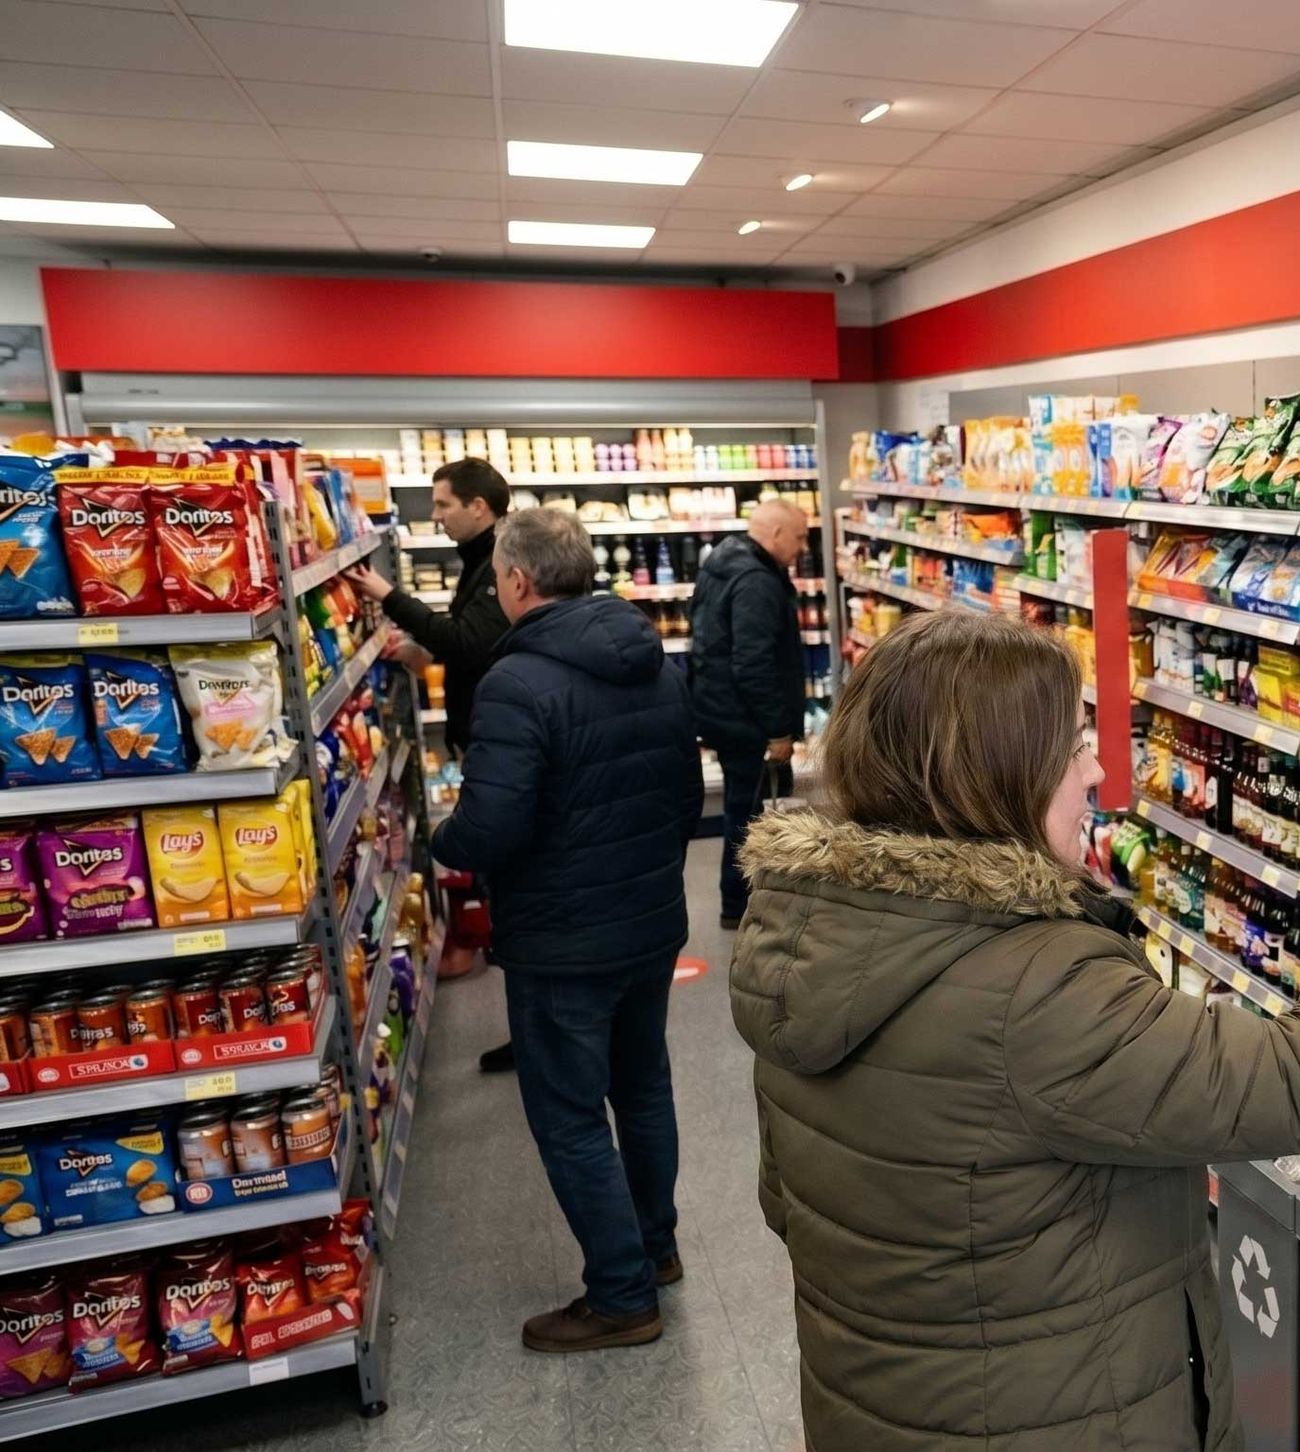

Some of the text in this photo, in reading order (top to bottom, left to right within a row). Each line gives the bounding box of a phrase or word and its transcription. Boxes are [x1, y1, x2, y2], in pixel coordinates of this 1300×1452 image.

[72, 508, 145, 526] Doritos
[166, 508, 234, 525] Doritos
[3, 682, 74, 703] Doritos
[94, 679, 159, 698] Doritos
[56, 847, 123, 867] Doritos
[166, 1277, 231, 1300] Doritos
[73, 1295, 141, 1318] Doritos
